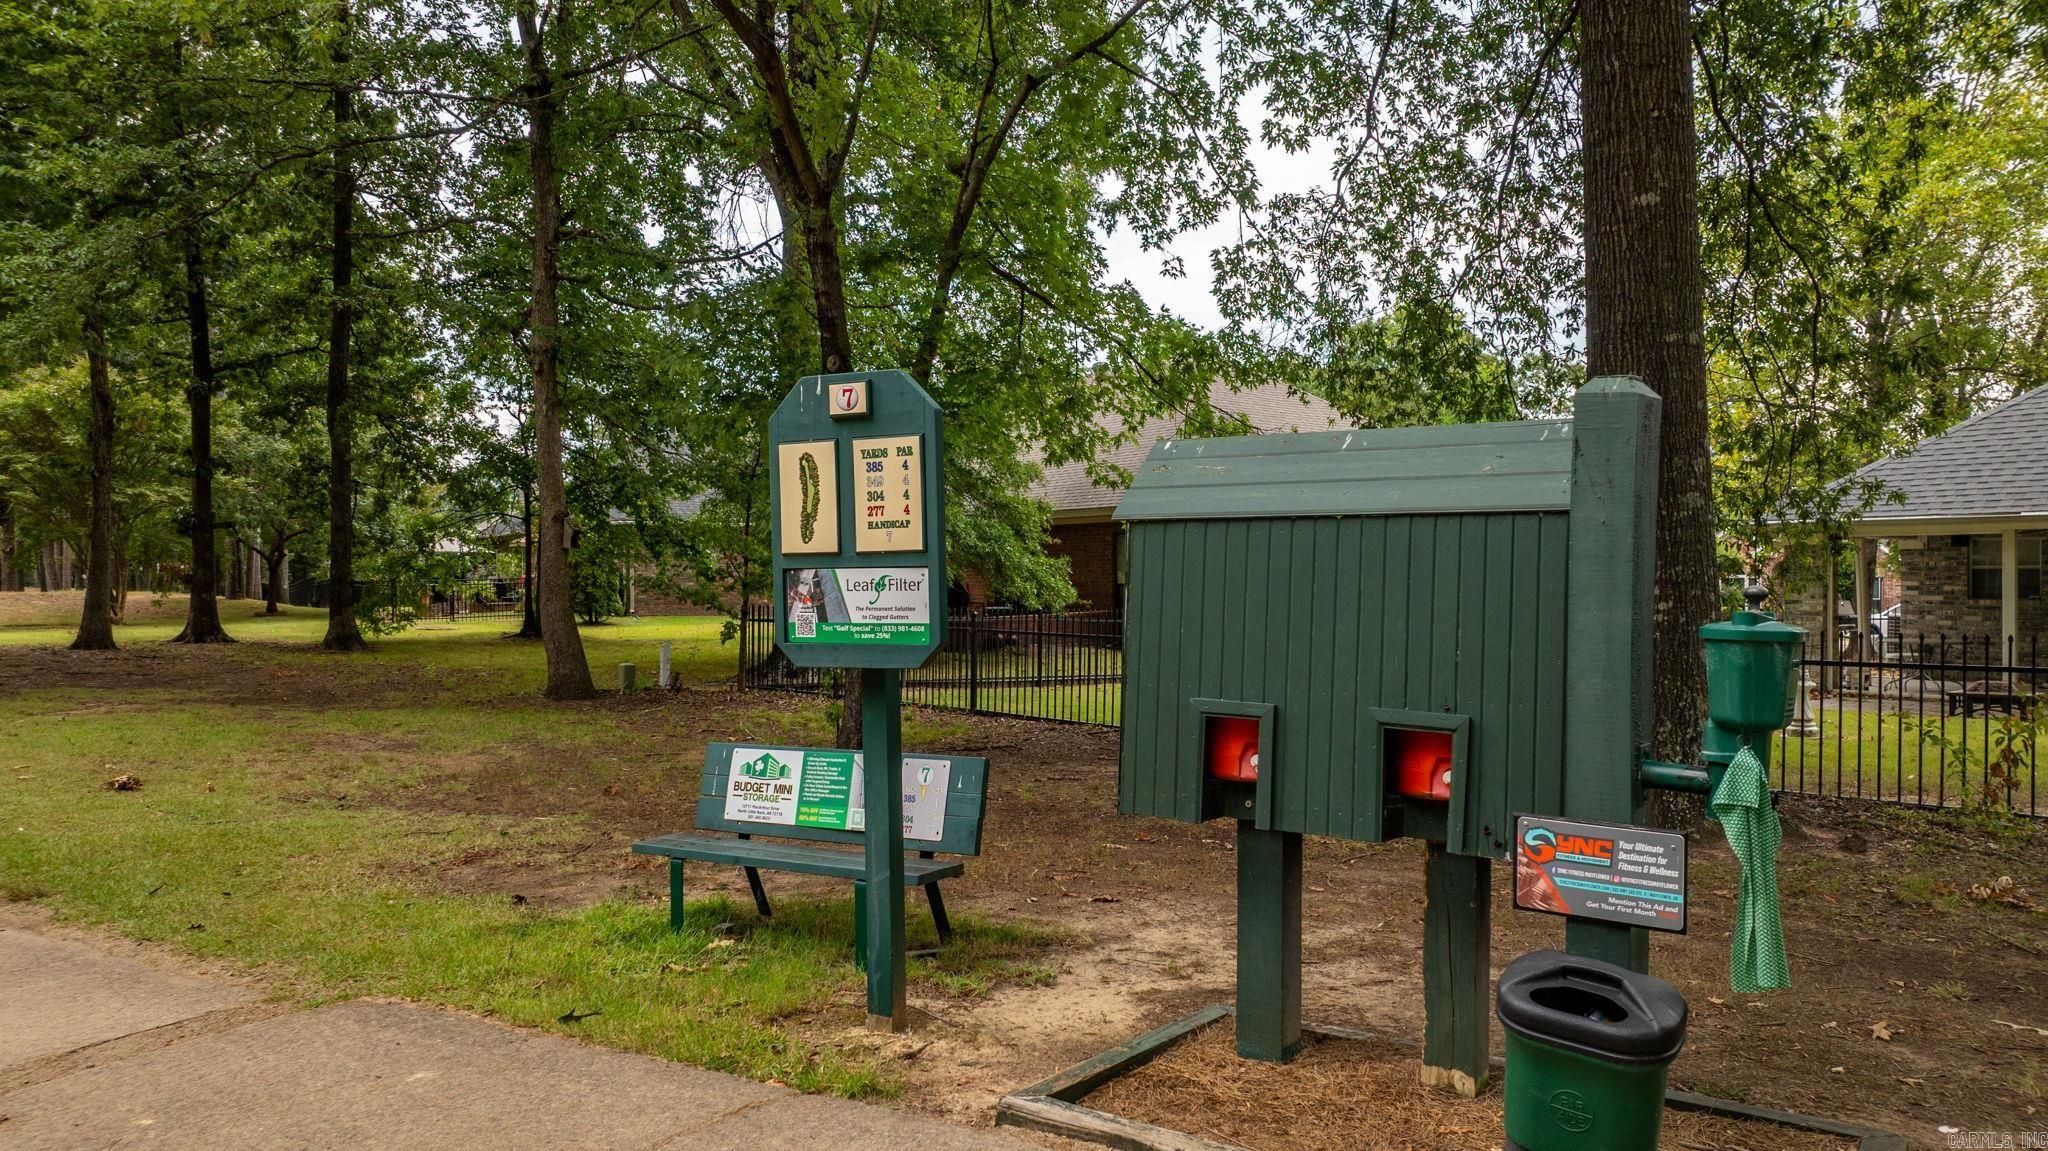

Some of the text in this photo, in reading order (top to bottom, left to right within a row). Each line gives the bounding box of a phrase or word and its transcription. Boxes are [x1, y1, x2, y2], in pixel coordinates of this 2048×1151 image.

[842, 389, 853, 408] 7
[860, 446, 914, 459] YARDS PAR
[866, 459, 909, 472] 385 4
[902, 474, 910, 486] 4
[866, 488, 910, 502] 304 4
[867, 504, 910, 517] 277 4
[867, 520, 911, 530] HANDICAP
[886, 530, 893, 542] 7
[868, 614, 888, 622] Clogged
[882, 625, 897, 633] (833)
[922, 766, 930, 783] 7
[734, 781, 771, 793] BUDGET
[774, 784, 793, 795] MINI
[743, 793, 780, 803] STORAGE
[904, 794, 916, 803] 385
[903, 825, 913, 834] 77
[1619, 840, 1664, 854] Your Ultimate
[1581, 856, 1609, 865] MOVEMENT
[1618, 851, 1668, 865] Destination for
[1585, 870, 1610, 880] MAYFLOWER
[1618, 862, 1679, 877] Fitness & Wellness
[1586, 901, 1599, 909] Get
[1617, 906, 1632, 914] First
[1633, 908, 1657, 917] Month
[1608, 897, 1636, 906] Mention
[1638, 901, 1652, 909] This
